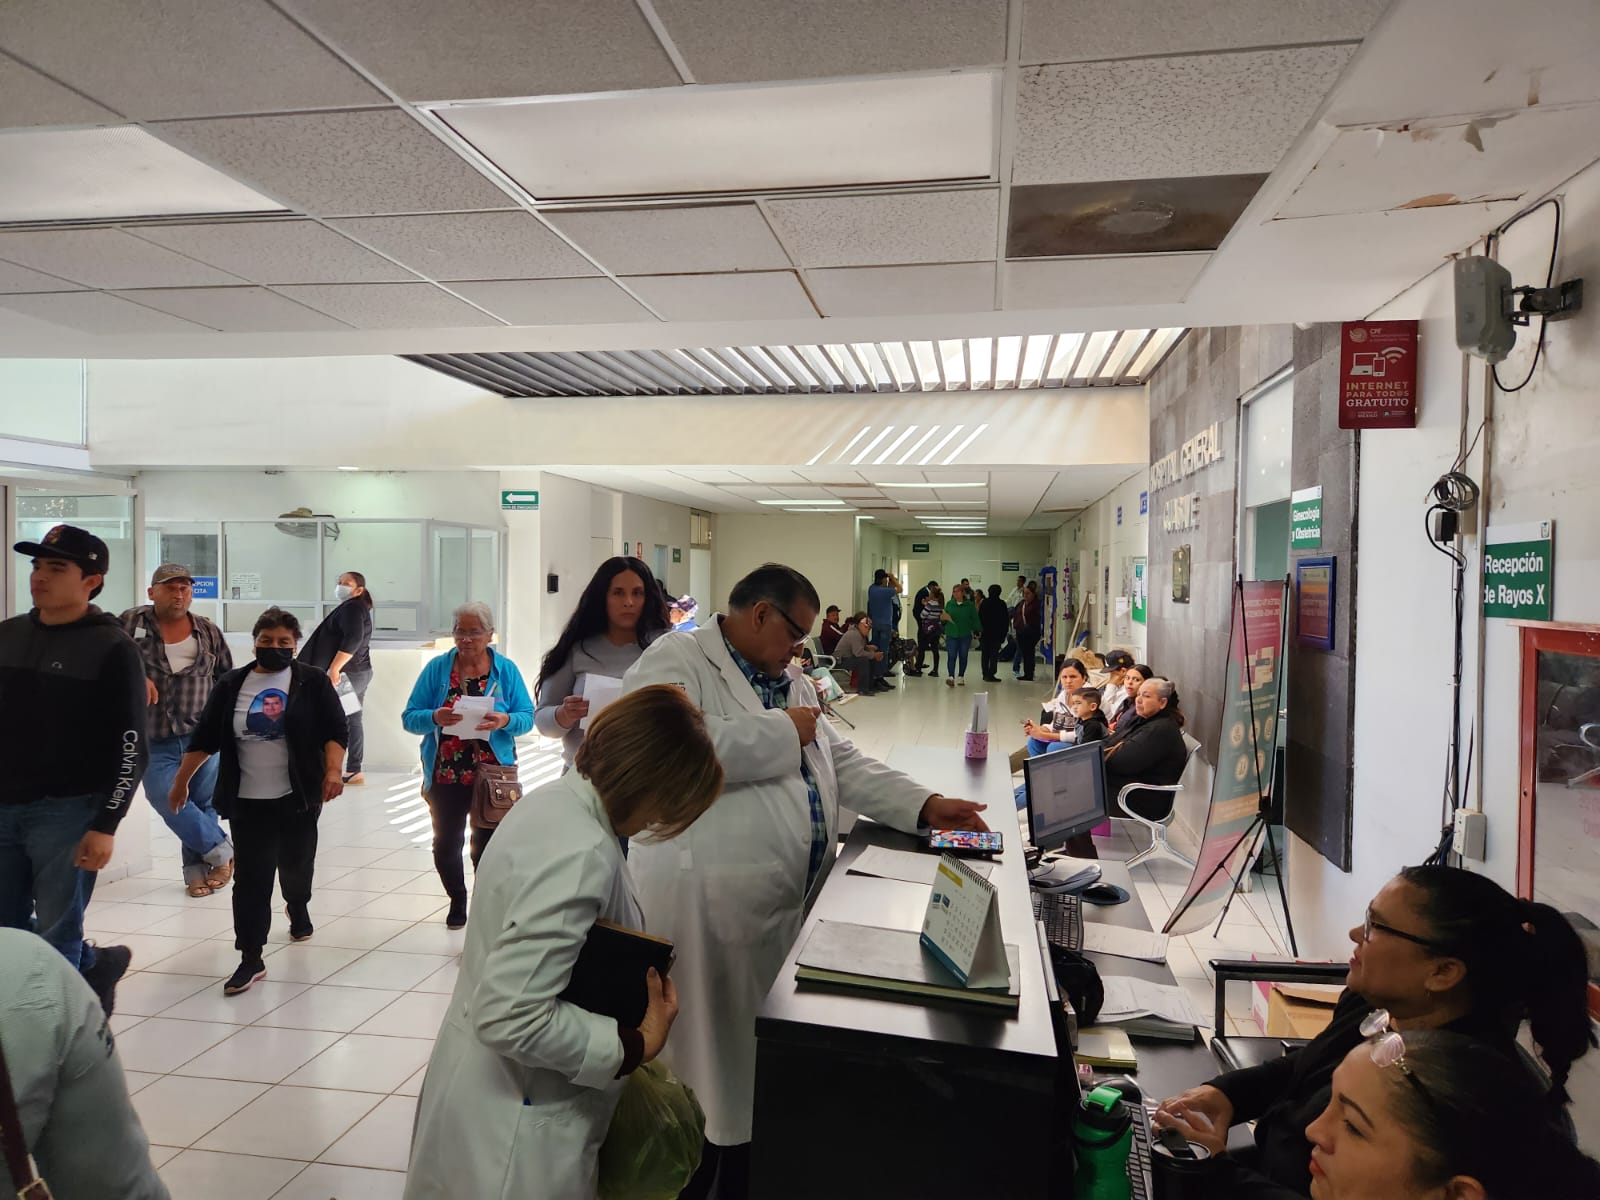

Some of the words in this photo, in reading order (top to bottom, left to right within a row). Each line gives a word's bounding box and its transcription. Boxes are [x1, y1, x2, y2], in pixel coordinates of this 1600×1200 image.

[1346, 381, 1409, 390] INTERNET
[1346, 398, 1409, 407] GRATUITO
[1181, 421, 1222, 477] GENERAL
[1484, 552, 1544, 577] Recepción
[1498, 584, 1534, 609] Rayos
[1535, 583, 1546, 605] X
[120, 730, 139, 775] Calvin
[105, 777, 134, 810] Klein
